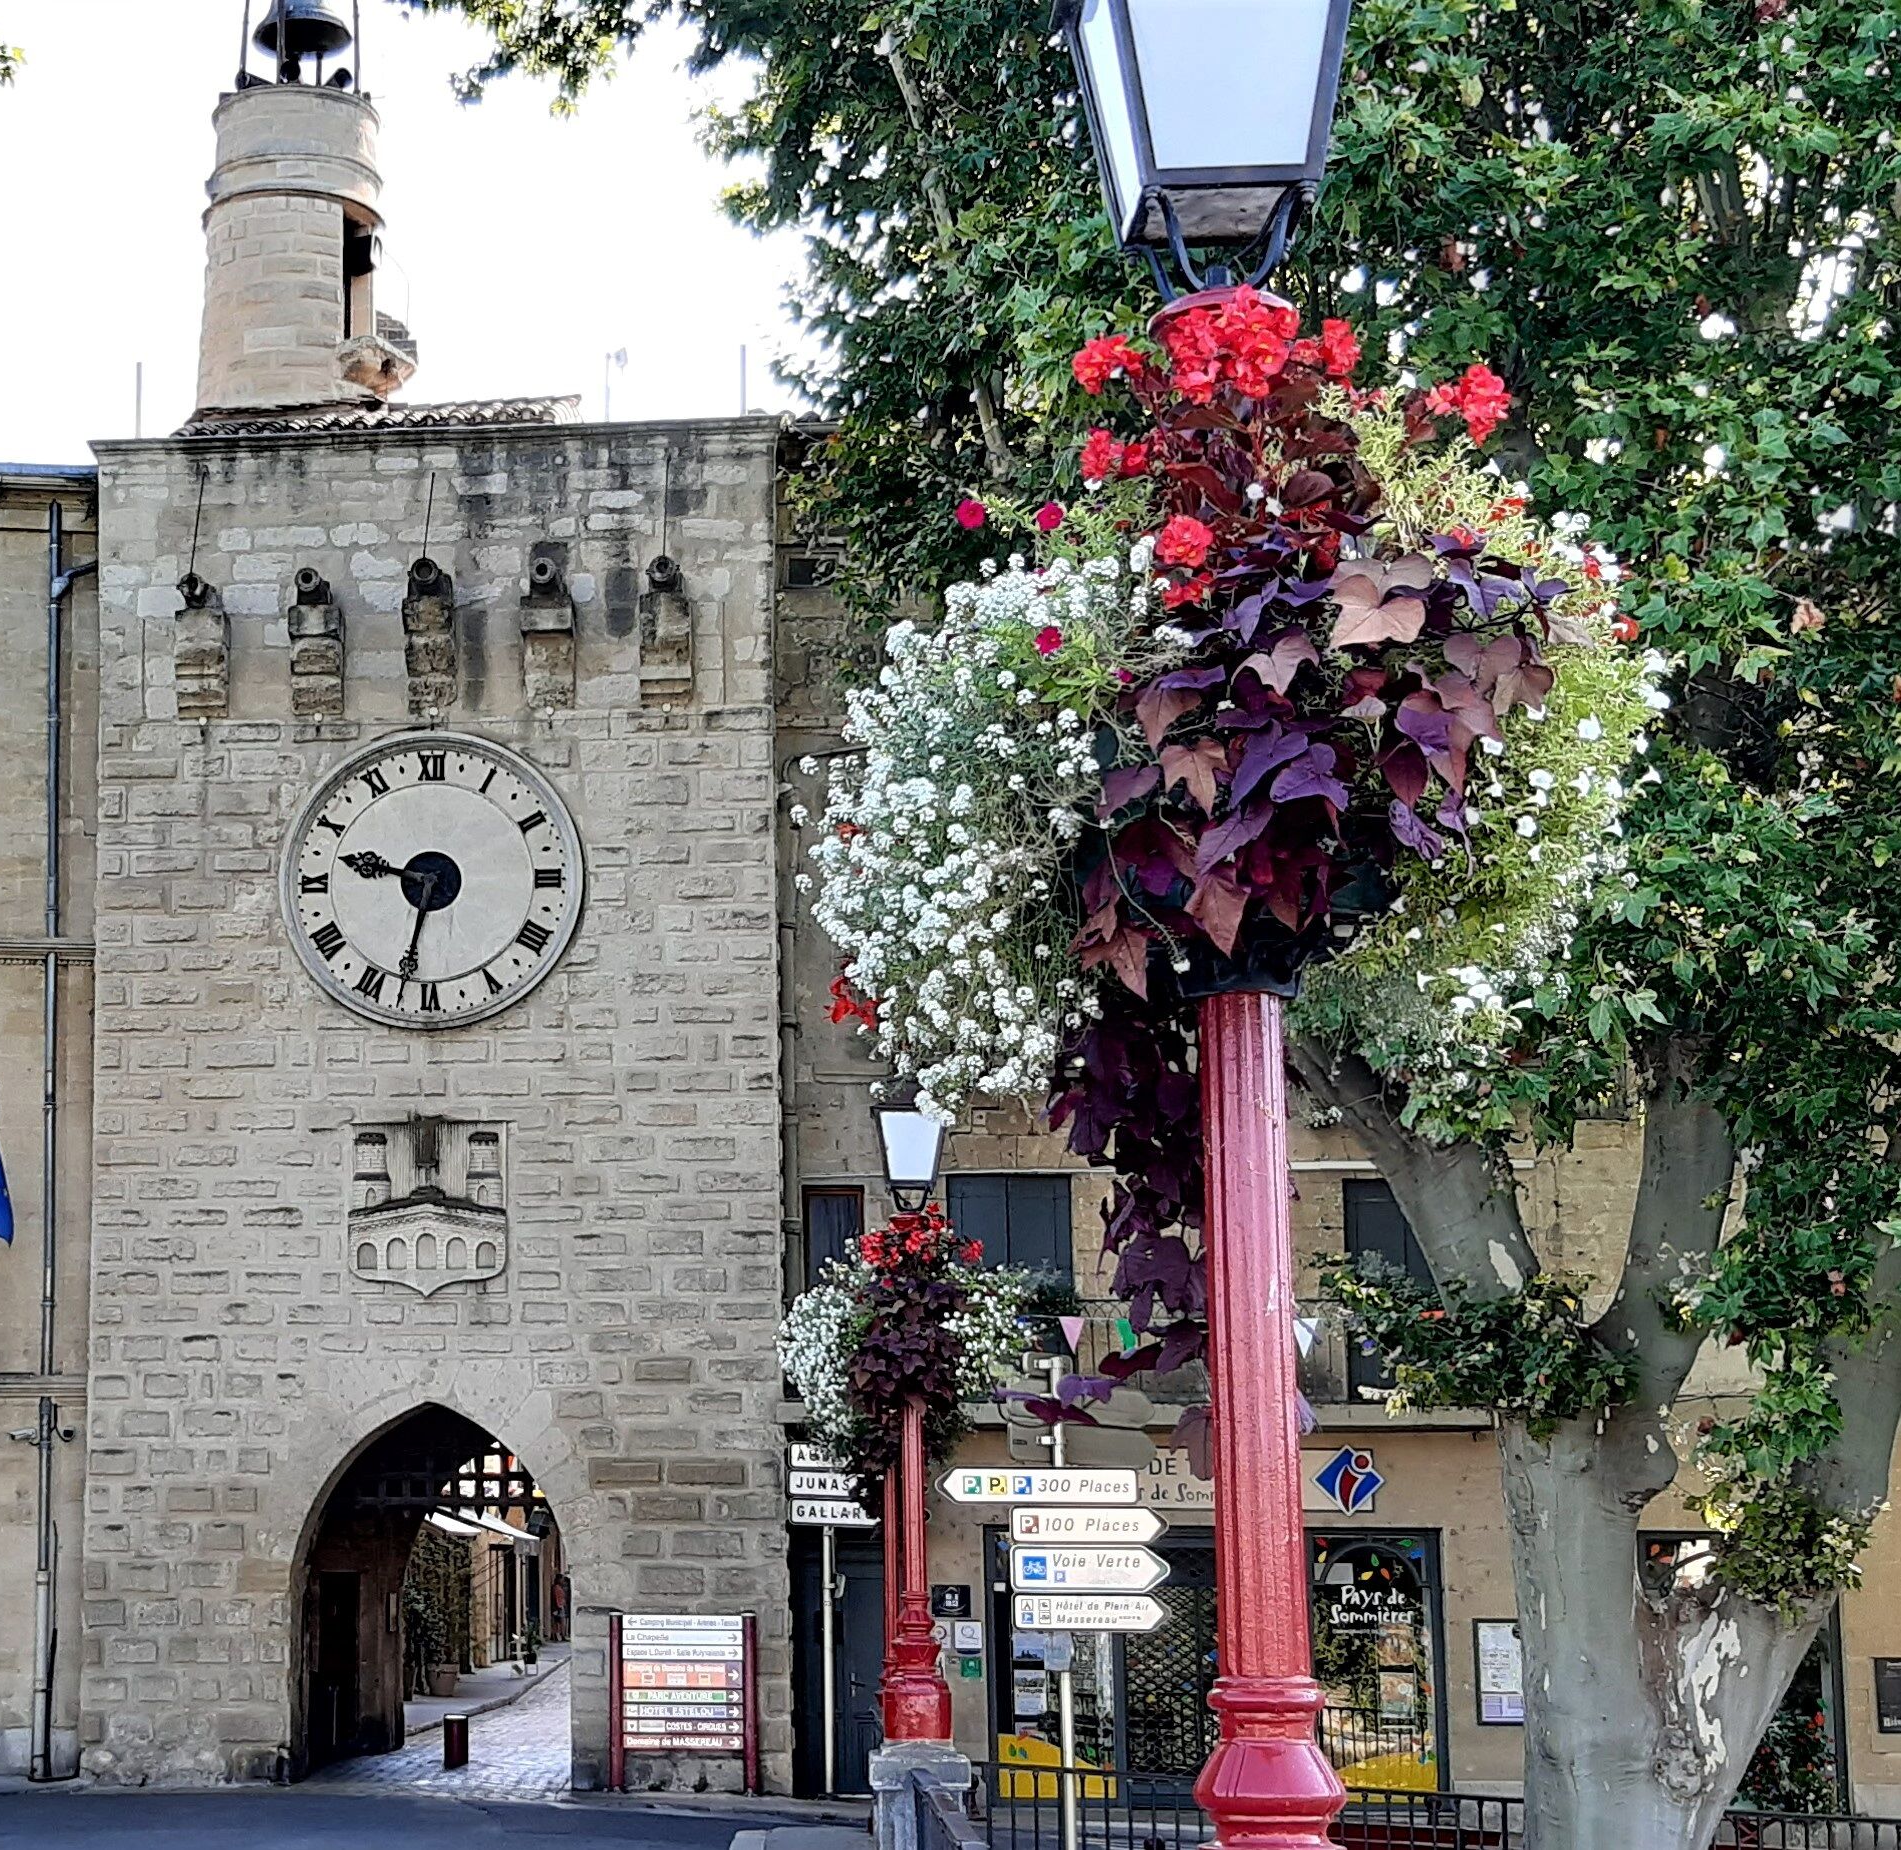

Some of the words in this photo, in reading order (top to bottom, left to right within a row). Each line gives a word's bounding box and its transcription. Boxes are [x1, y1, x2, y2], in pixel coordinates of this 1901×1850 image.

[417, 750, 447, 781] XII
[360, 767, 390, 799] XI
[478, 766, 498, 794] I
[317, 815, 346, 837] X
[518, 810, 547, 834] II
[301, 873, 329, 894] IX
[534, 868, 562, 889] III
[309, 920, 347, 961] VIII
[352, 965, 386, 1003] VII
[482, 968, 503, 994] V
[420, 982, 440, 1011] VI
[1149, 1457, 1177, 1476] DE
[796, 1476, 850, 1491] JUNAS
[1037, 1479, 1070, 1493] 300
[1079, 1479, 1129, 1494] Places
[1151, 1484, 1169, 1500] de
[796, 1505, 870, 1519] GALLAR
[1044, 1517, 1075, 1532] 100
[1085, 1517, 1140, 1532] Places
[1052, 1553, 1086, 1568] Voie
[1096, 1553, 1141, 1568] Verte
[1056, 1600, 1083, 1611] Hôtel
[1087, 1601, 1099, 1611] de
[1340, 1585, 1383, 1609] Pays
[1387, 1587, 1405, 1605] de
[1329, 1603, 1414, 1624] Sommières
